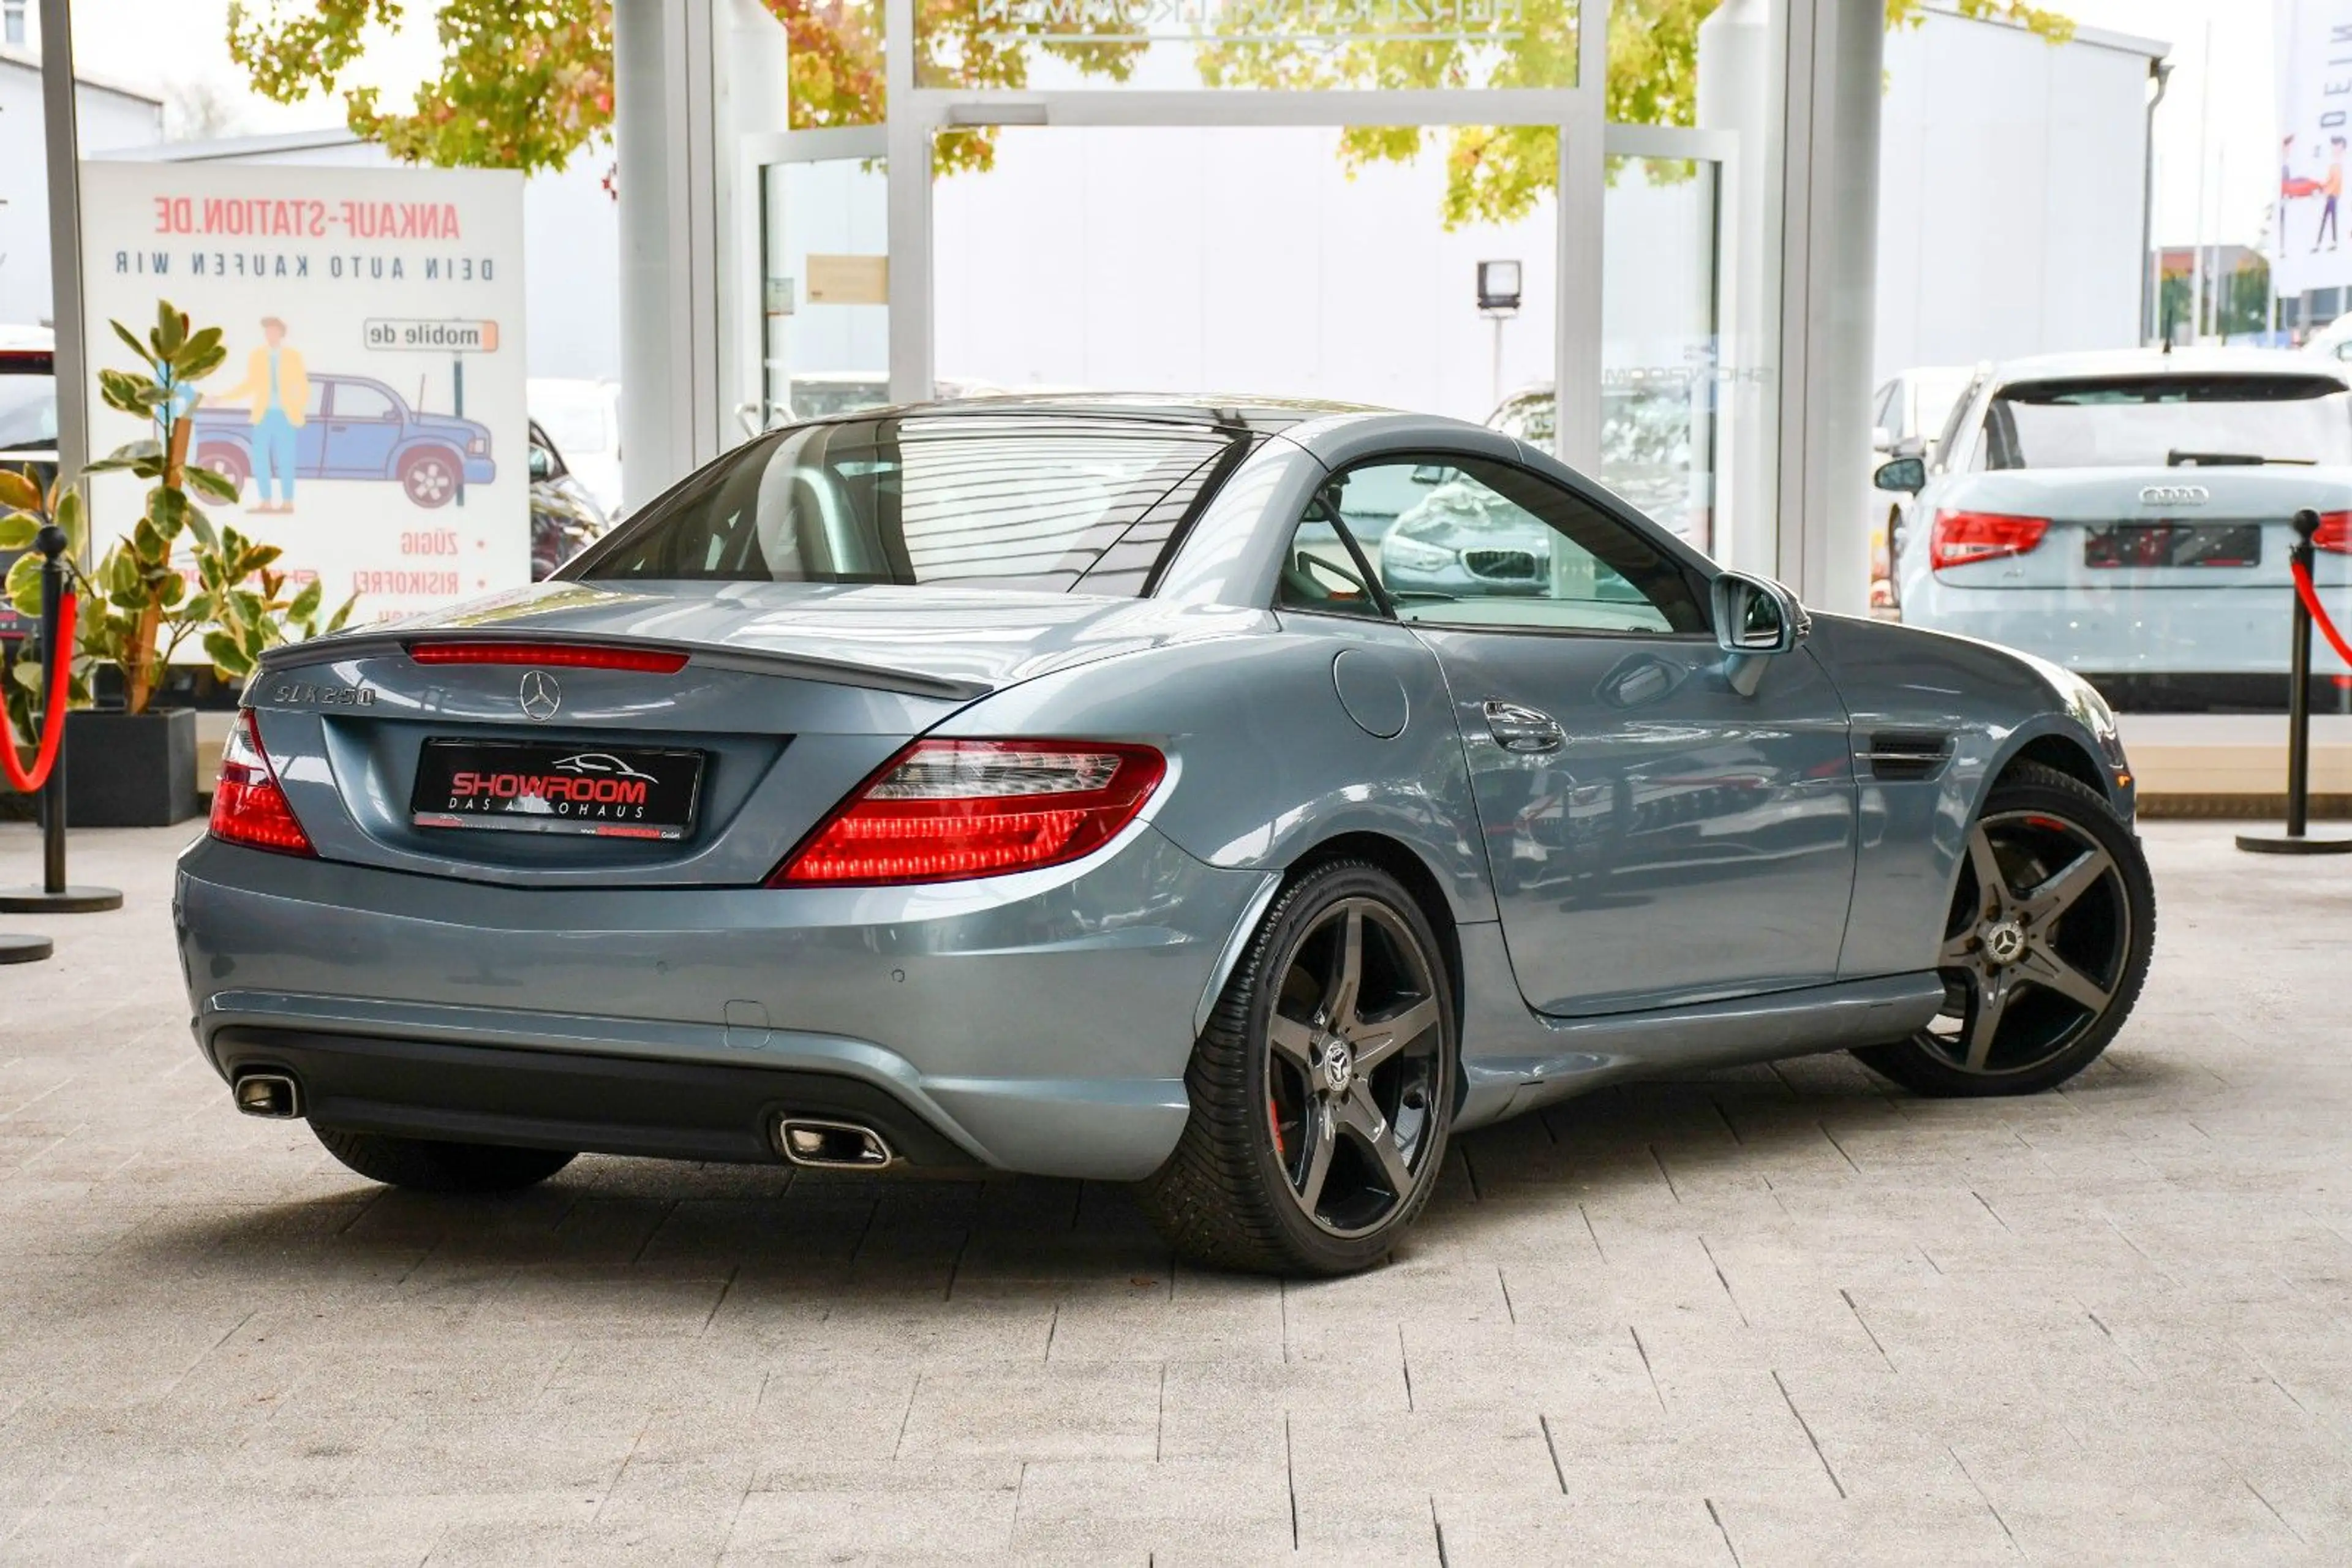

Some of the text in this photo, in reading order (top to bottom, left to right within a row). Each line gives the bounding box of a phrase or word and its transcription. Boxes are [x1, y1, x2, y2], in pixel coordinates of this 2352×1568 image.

[451, 772, 647, 804] SHOWROOM
[448, 797, 644, 818] DAS AUTOHAUS
